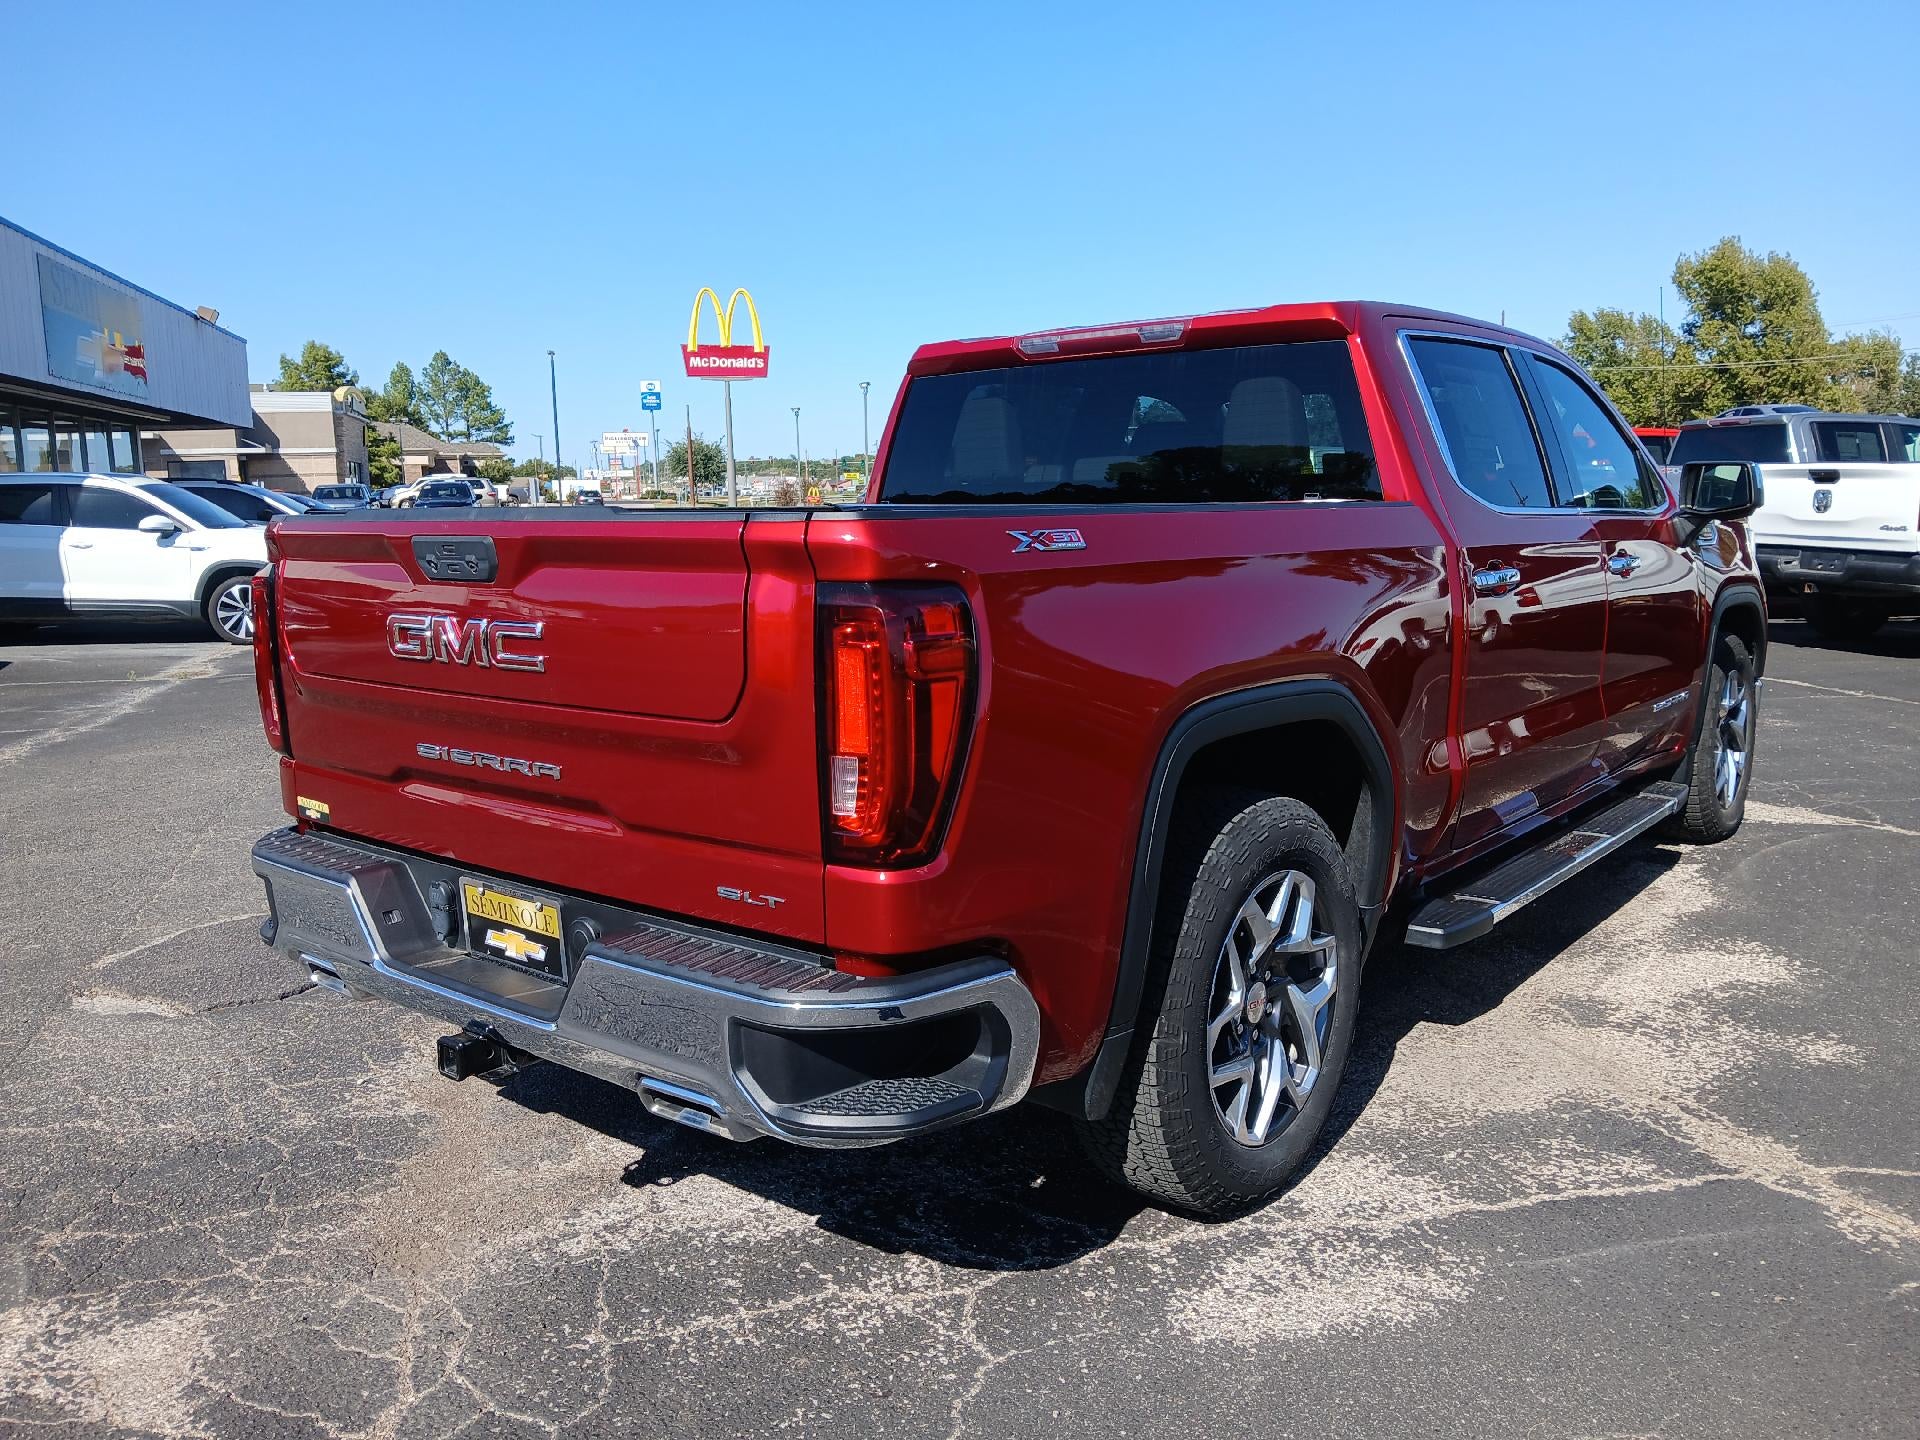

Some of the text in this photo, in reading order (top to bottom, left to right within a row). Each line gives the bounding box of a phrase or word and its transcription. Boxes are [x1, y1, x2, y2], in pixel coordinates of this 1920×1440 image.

[689, 356, 765, 368] McDonald's
[386, 614, 546, 673] GMC
[416, 743, 563, 781] SIERRA
[471, 894, 555, 935] SEMINOLE
[717, 886, 786, 908] SLT
